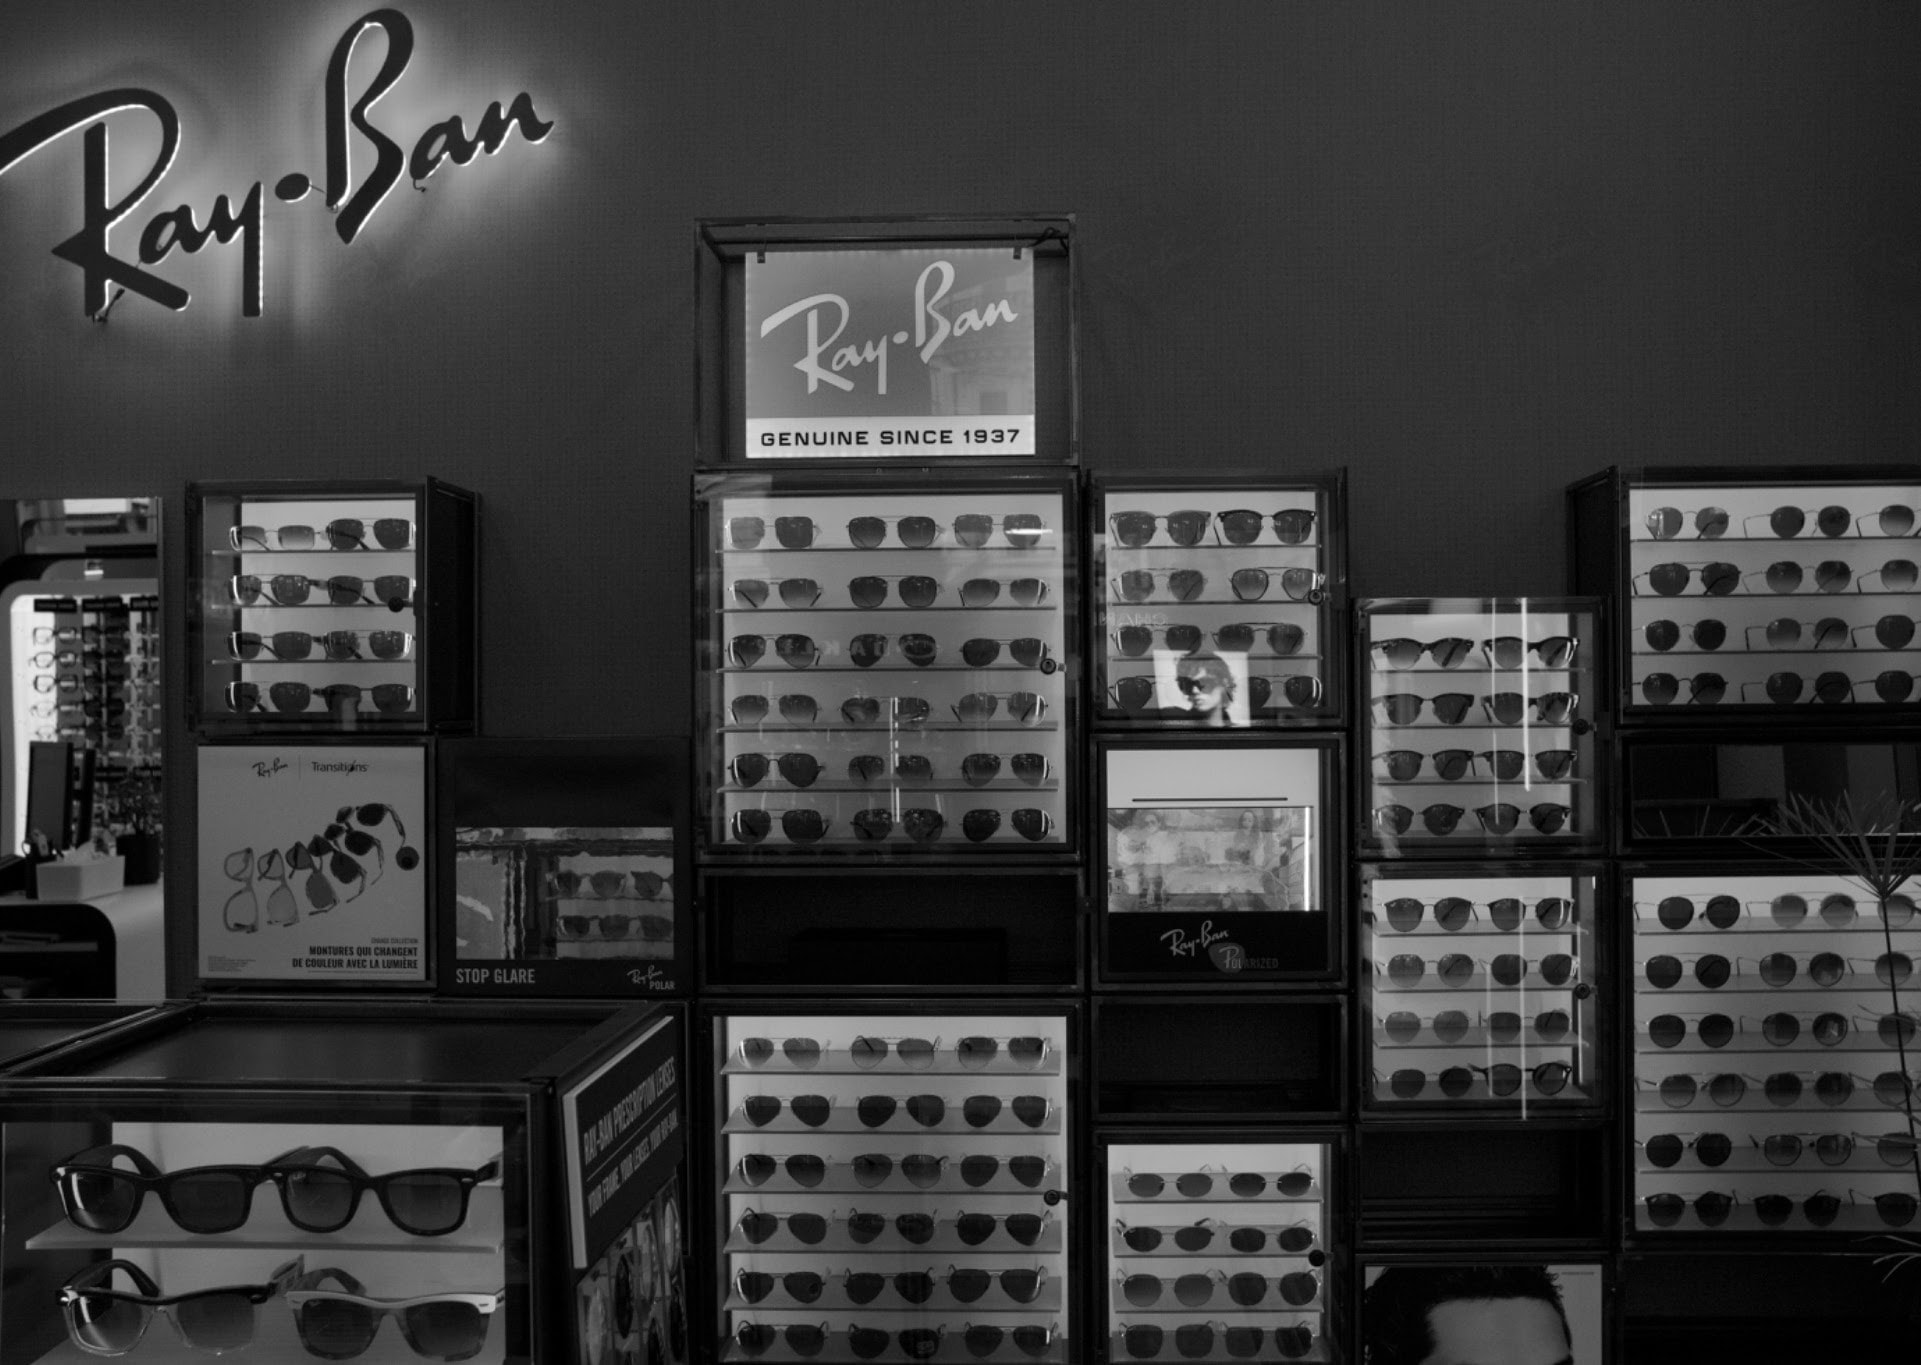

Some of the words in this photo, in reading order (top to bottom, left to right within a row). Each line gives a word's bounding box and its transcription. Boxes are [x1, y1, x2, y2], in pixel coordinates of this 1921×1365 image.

[761, 431, 869, 447] GENUINE
[880, 429, 954, 445] SINCE
[963, 428, 1021, 444] 1937
[309, 946, 354, 956] MONTURES
[356, 946, 372, 957] QUI
[374, 947, 418, 957] CHANGENT
[292, 958, 303, 968] DE
[305, 958, 344, 968] COULEUR
[346, 958, 367, 969] AVEC
[369, 959, 380, 969] LA
[382, 957, 418, 969] LUMIÈRE
[455, 968, 489, 984] STOP
[493, 968, 536, 984] GLARE
[649, 980, 676, 990] POLAR
[583, 1109, 614, 1167] RAY-BAN
[655, 1055, 676, 1098] LENSES
